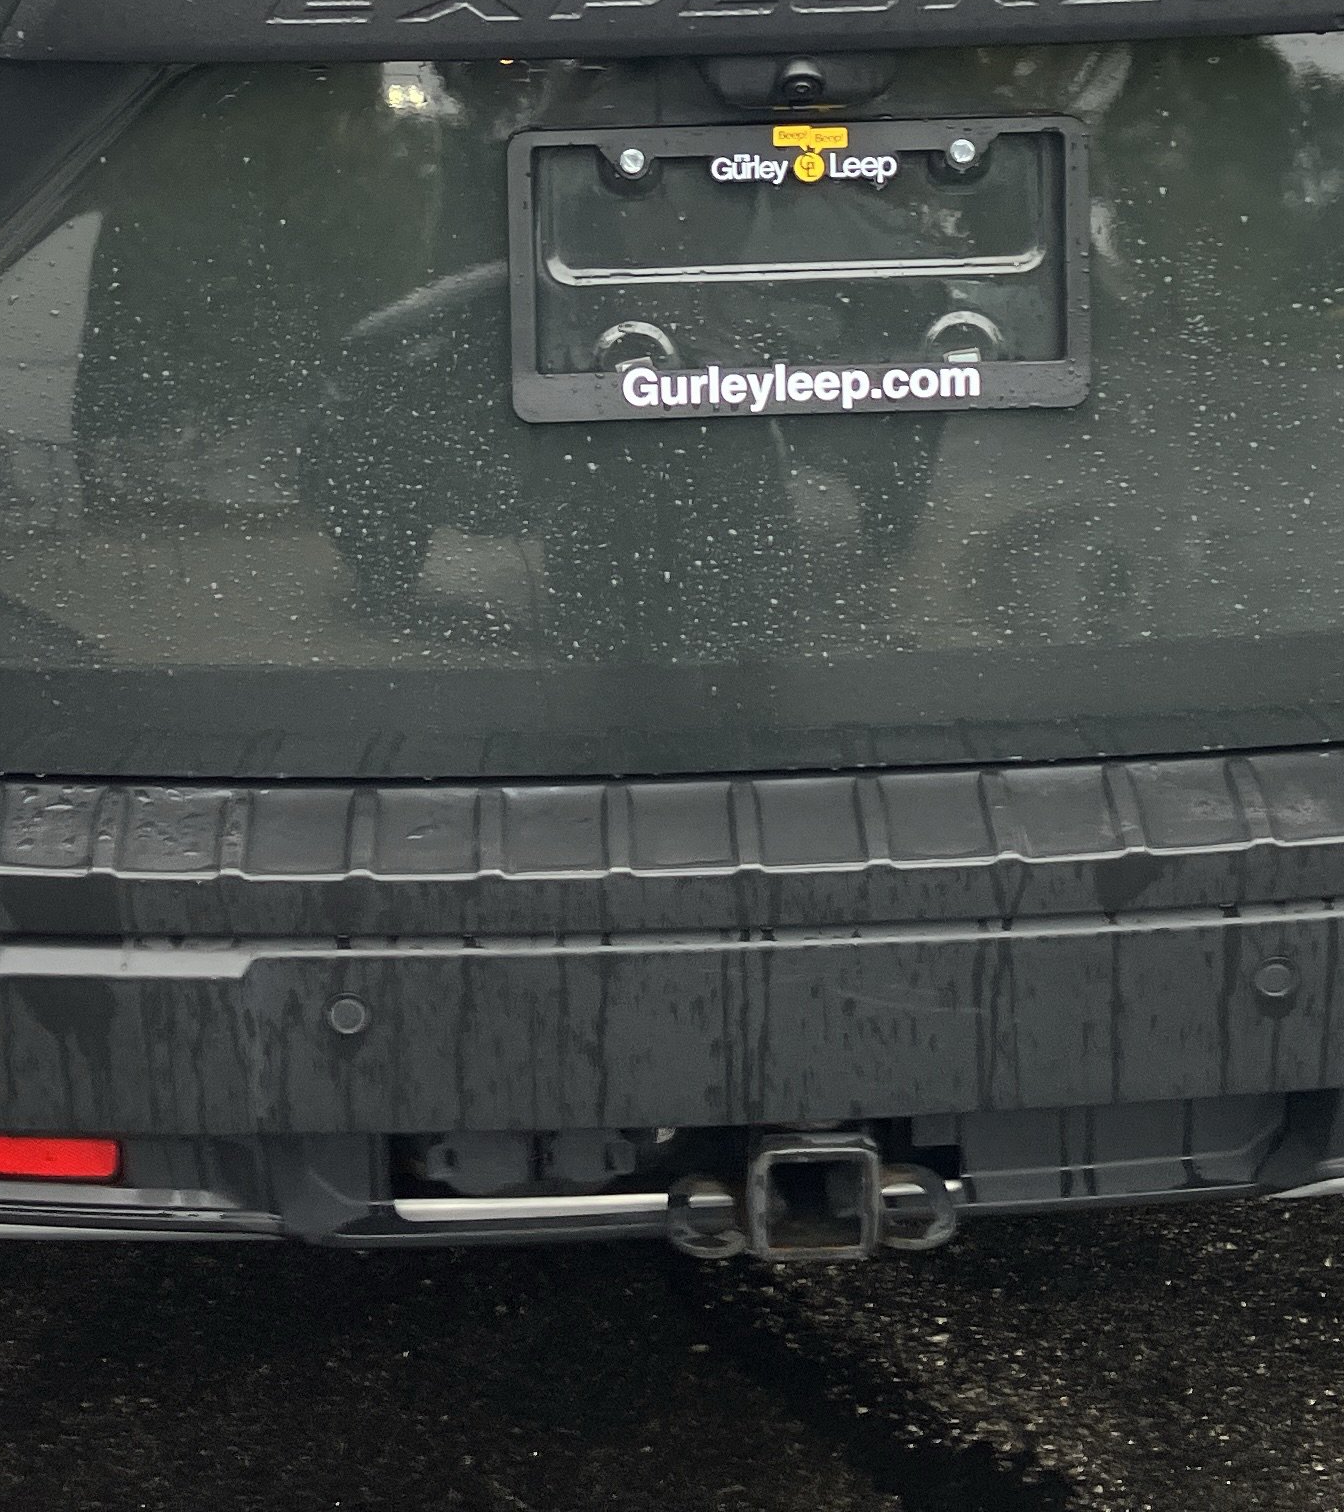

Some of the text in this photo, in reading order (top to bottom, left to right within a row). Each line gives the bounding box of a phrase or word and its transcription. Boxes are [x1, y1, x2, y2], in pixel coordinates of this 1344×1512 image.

[711, 154, 789, 185] Gurley
[829, 152, 898, 184] Leep
[621, 363, 981, 413] Gurleyleep.com
